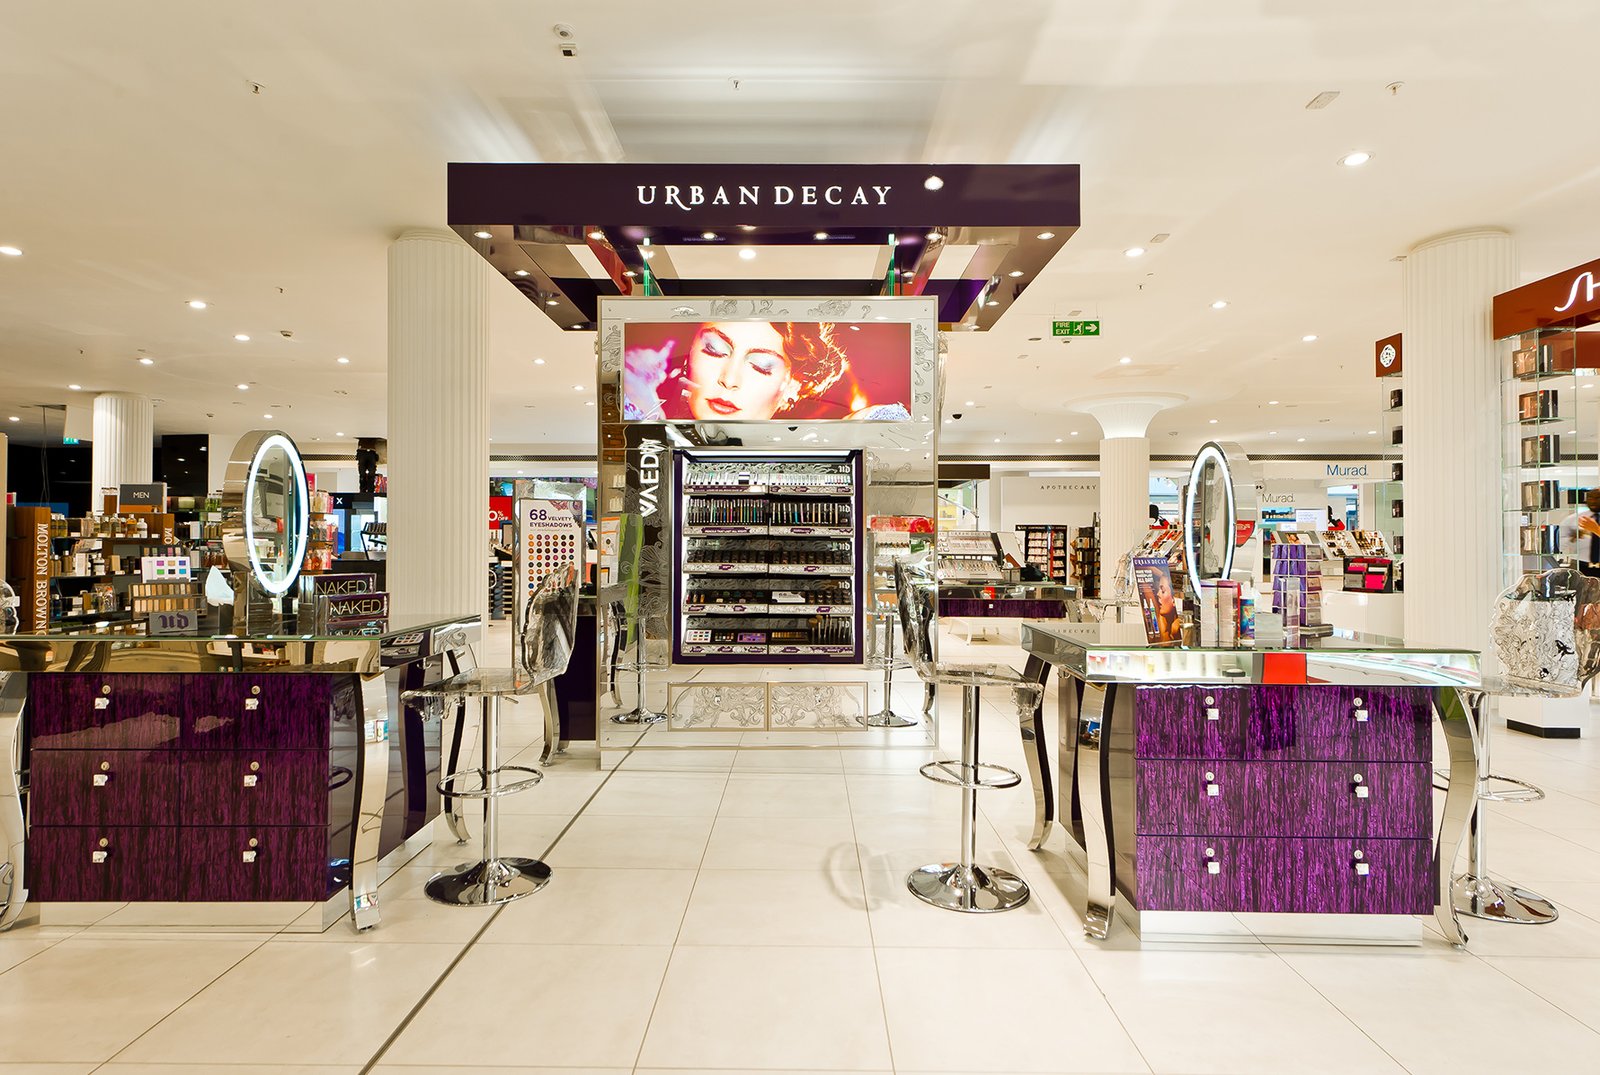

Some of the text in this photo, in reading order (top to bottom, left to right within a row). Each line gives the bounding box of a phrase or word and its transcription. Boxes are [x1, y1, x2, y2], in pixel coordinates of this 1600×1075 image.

[636, 186, 892, 211] URBAN DECAY
[133, 491, 150, 499] MEN
[529, 509, 547, 520] 68
[36, 523, 49, 577] MOLTON
[315, 580, 367, 595] NAKED
[329, 599, 382, 616] NAKED
